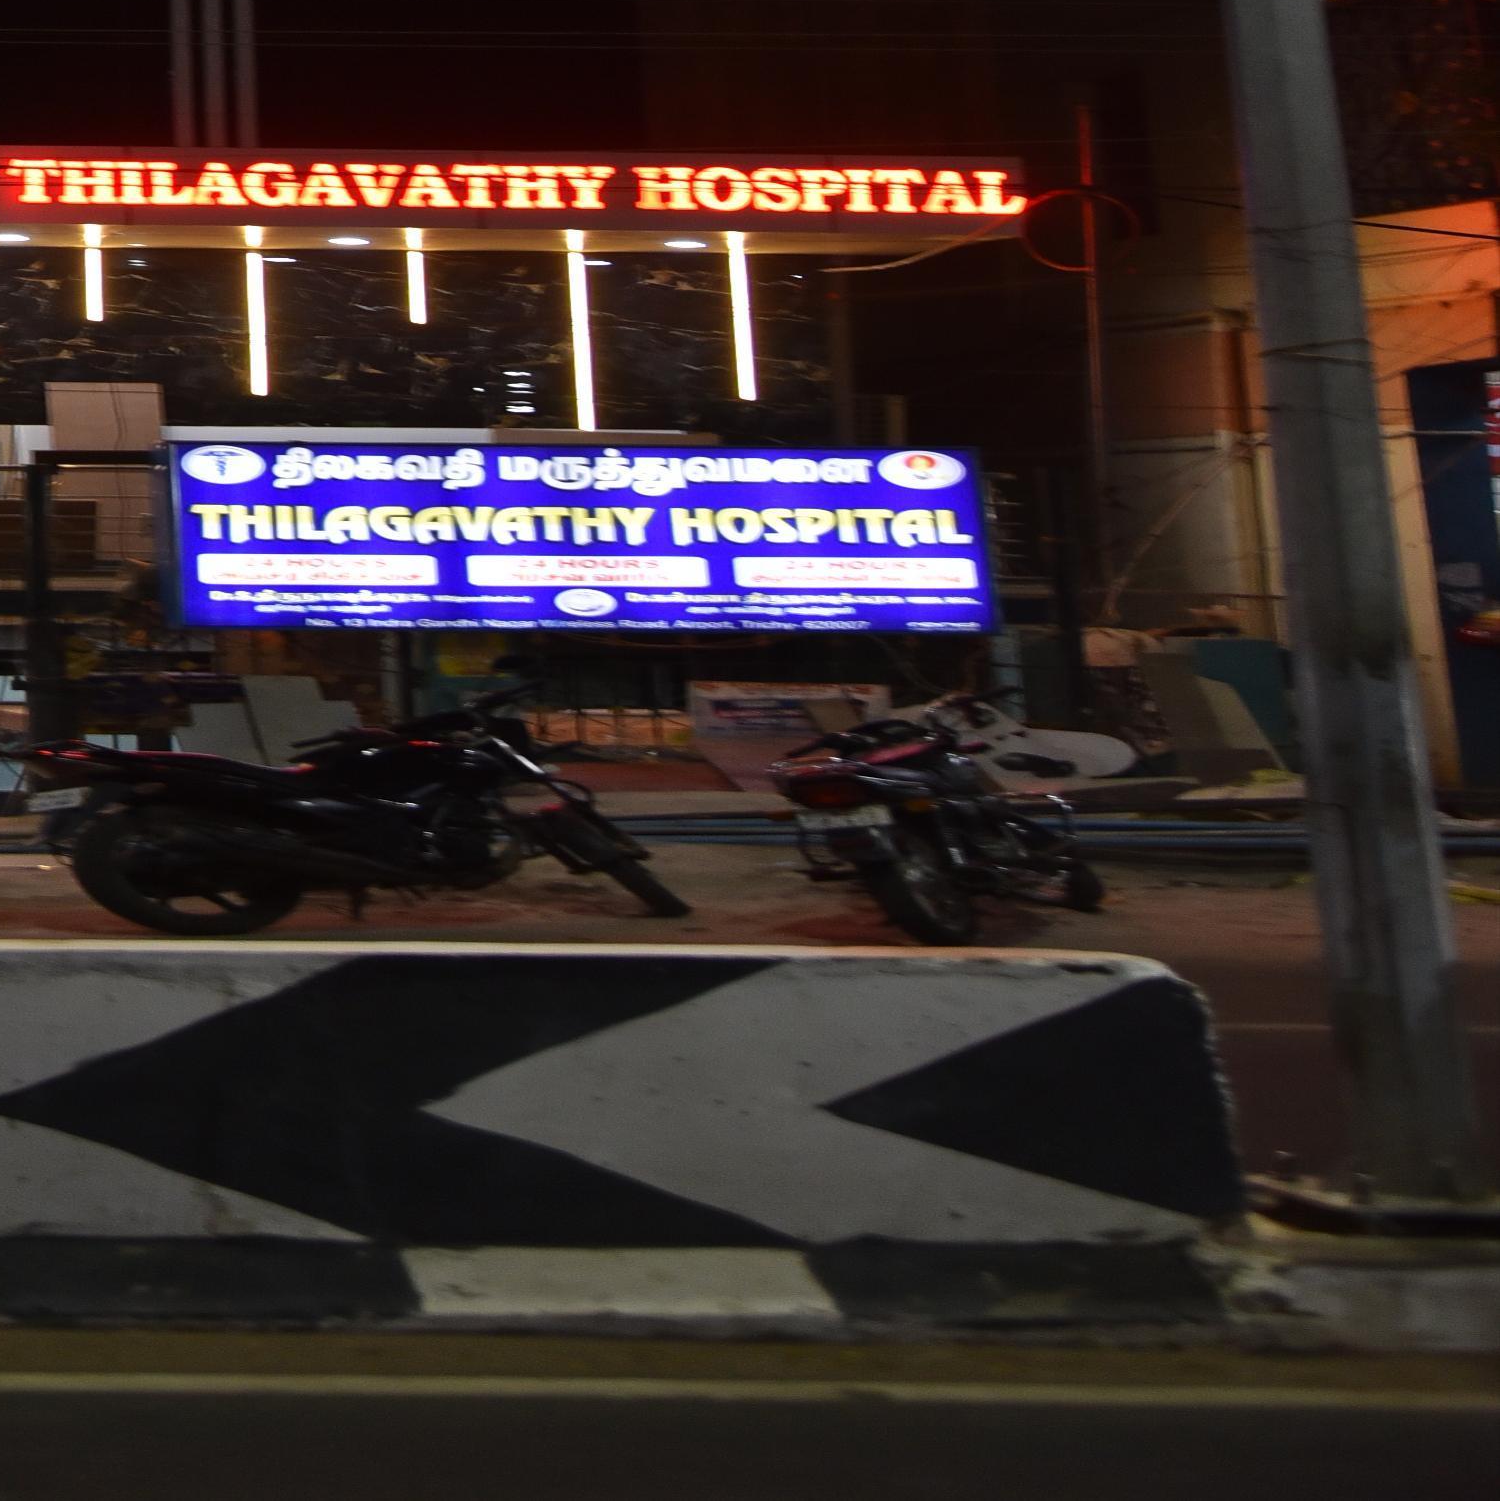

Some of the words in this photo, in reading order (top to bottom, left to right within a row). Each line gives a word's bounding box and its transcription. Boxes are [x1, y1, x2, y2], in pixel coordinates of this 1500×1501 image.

[4, 158, 616, 212] THILAGAVATHY
[631, 164, 1029, 215] HOSPITAL
[271, 446, 486, 490] திலகவதி
[497, 447, 873, 497] மருத்துவமனை
[189, 503, 655, 546] THILAGAVATHY
[668, 506, 974, 548] HOSPITAL
[557, 558, 661, 570] HOURS
